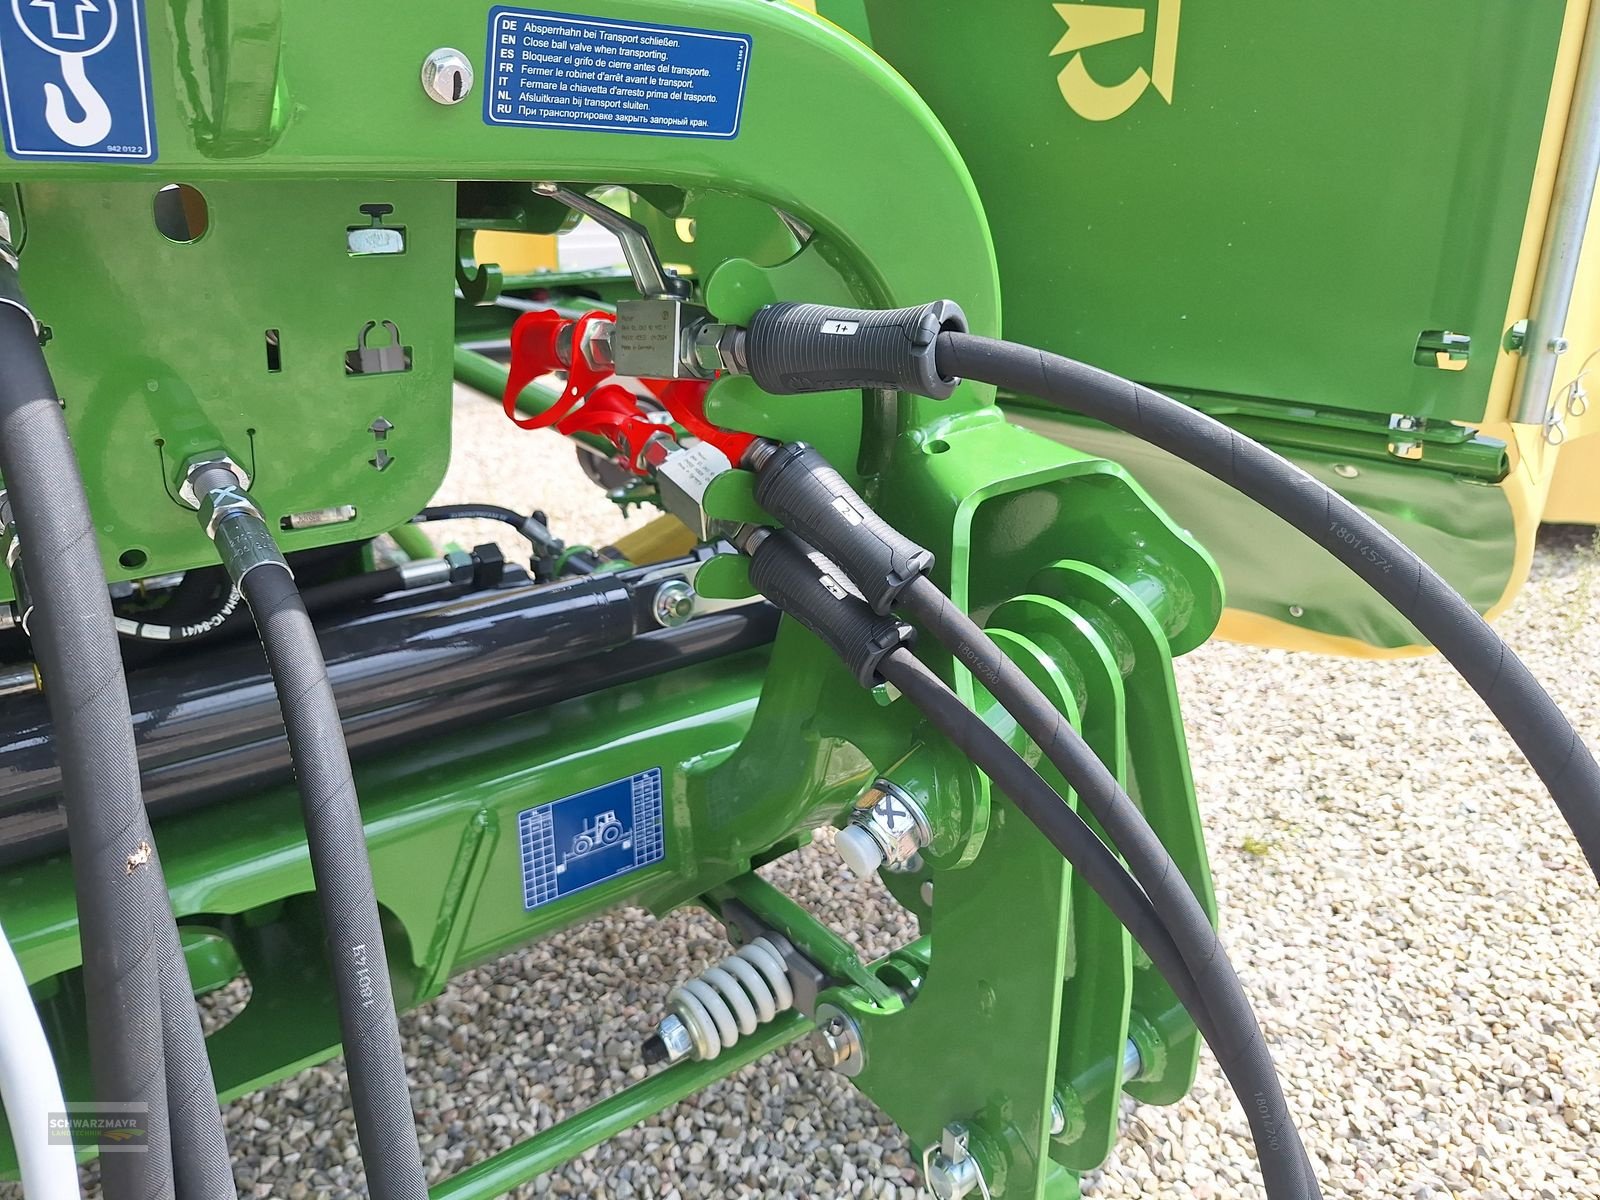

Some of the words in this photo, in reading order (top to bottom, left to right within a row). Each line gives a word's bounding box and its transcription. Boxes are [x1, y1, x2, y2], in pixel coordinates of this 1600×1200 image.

[502, 20, 518, 30] DE
[524, 22, 581, 37] Absperrhahn
[584, 29, 597, 39] bei
[599, 30, 638, 44] Transport
[640, 37, 680, 48] schließen.
[501, 34, 516, 44] EN
[523, 36, 549, 48] Close
[552, 40, 567, 50] ball
[569, 41, 592, 52] valve
[594, 44, 616, 55] when
[619, 47, 668, 61] transporting.
[500, 49, 514, 58] ES
[522, 51, 562, 63] Bloquear
[565, 56, 572, 64] el
[574, 57, 593, 67] grifo
[595, 58, 606, 67] de
[608, 60, 631, 69] cierre
[634, 62, 657, 72] antes
[658, 64, 669, 73] del
[671, 65, 711, 77] transporte.
[500, 63, 513, 72] FR
[521, 65, 553, 76] Fermer
[556, 68, 564, 77] le
[566, 68, 595, 79] robinet
[597, 72, 623, 82] d'arrêt
[625, 75, 648, 85] avant
[649, 76, 656, 85] le
[658, 77, 694, 89] transport.
[498, 90, 511, 100] NL
[519, 92, 570, 104] Afsluitkraan
[572, 96, 582, 107] bij
[585, 98, 620, 109] transport
[622, 101, 650, 110] sluiten.
[499, 77, 508, 86] IT
[520, 79, 557, 90] Fermare
[560, 82, 568, 91] la
[570, 83, 607, 94] chiavetta
[610, 87, 644, 97] d'arresto
[646, 90, 668, 99] prima
[670, 91, 682, 100] del
[684, 93, 717, 103] trasporto.
[497, 104, 512, 114] RU
[519, 106, 536, 116] При
[539, 108, 612, 120] транспортировке
[615, 114, 648, 124] закрыть
[650, 117, 688, 126] запорный
[690, 119, 708, 128] кран.
[836, 324, 848, 332] 1+
